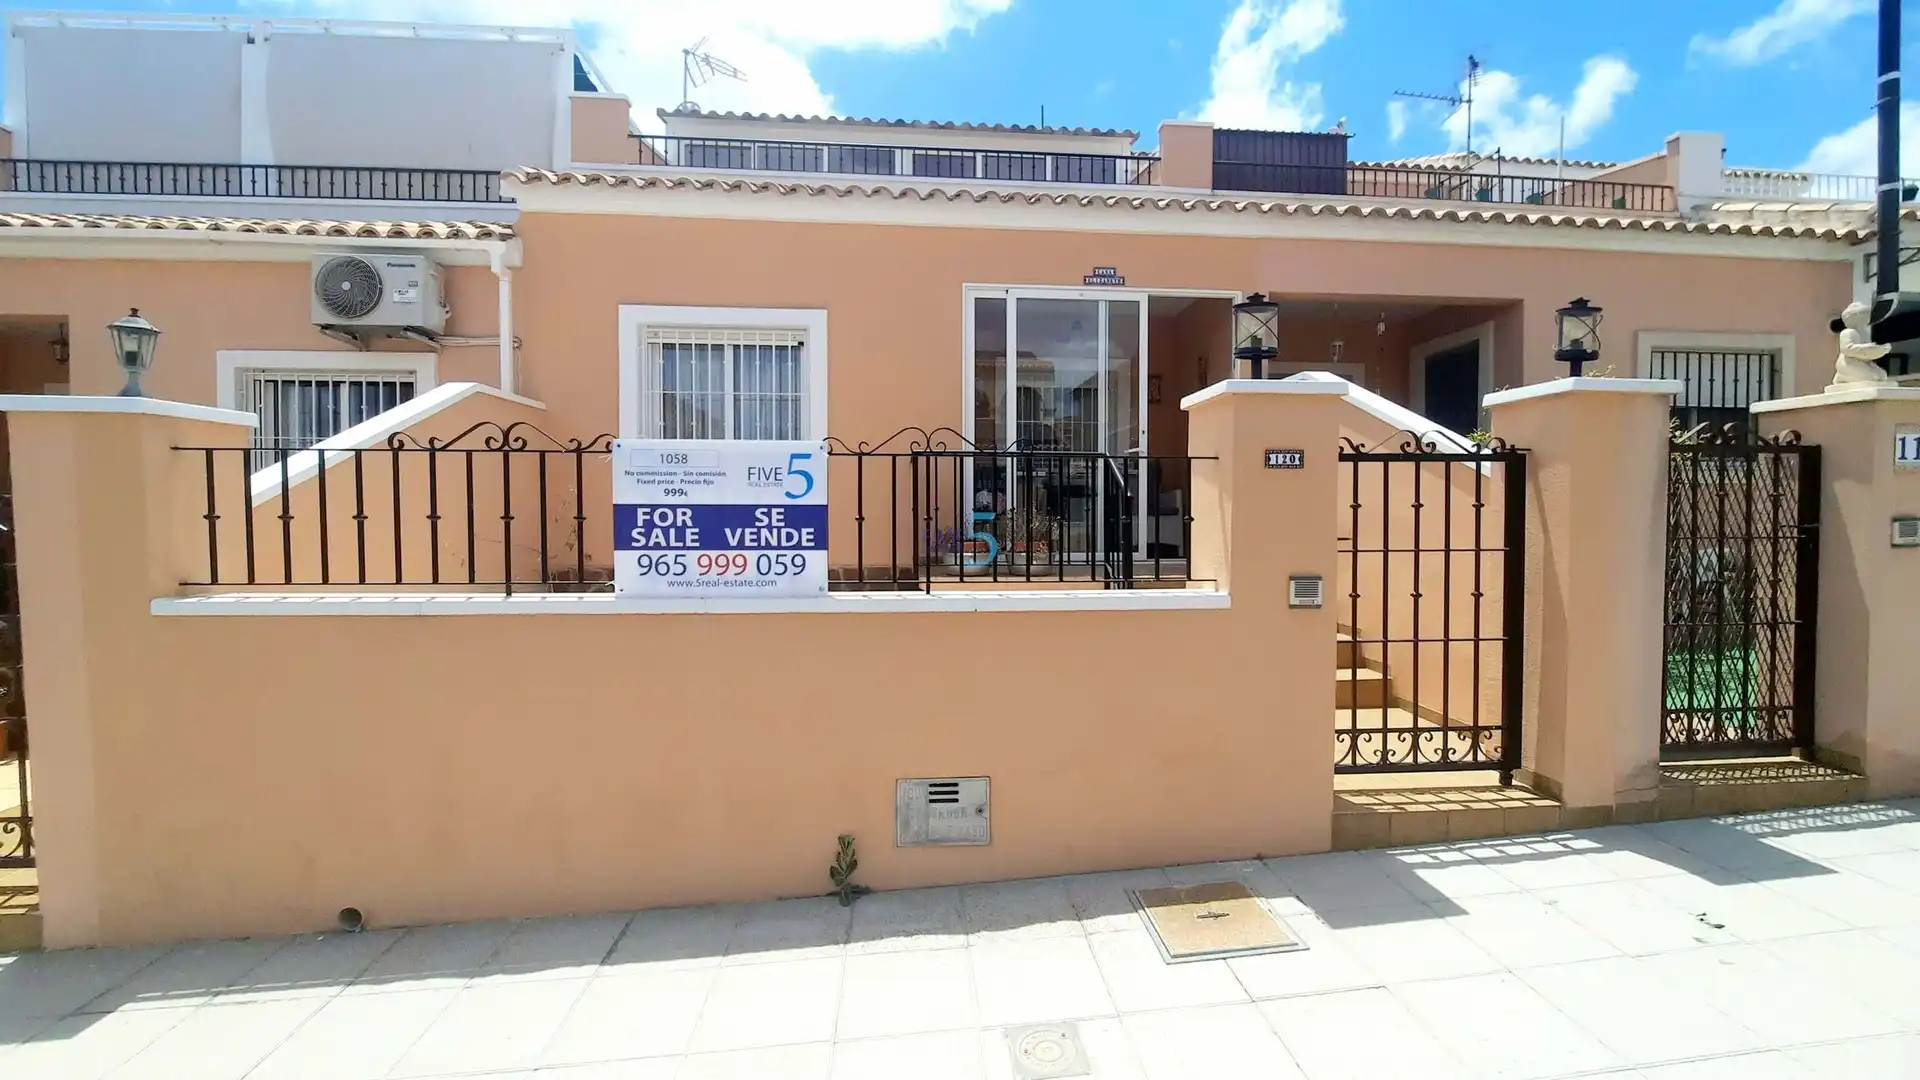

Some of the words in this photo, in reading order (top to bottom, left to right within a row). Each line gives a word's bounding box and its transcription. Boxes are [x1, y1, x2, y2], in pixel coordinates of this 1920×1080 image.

[660, 453, 688, 464] 1058
[1275, 454, 1296, 464] 120
[657, 479, 675, 487] price
[747, 467, 783, 481] FIVE
[784, 453, 814, 500] 5
[636, 508, 693, 527] FOR
[754, 508, 785, 527] SE
[631, 528, 700, 547] SALE
[724, 528, 815, 547] VENDE
[637, 554, 688, 576] 965
[697, 554, 748, 576] 999
[756, 554, 806, 576] 059
[667, 579, 777, 588] www.5real-estate.com
